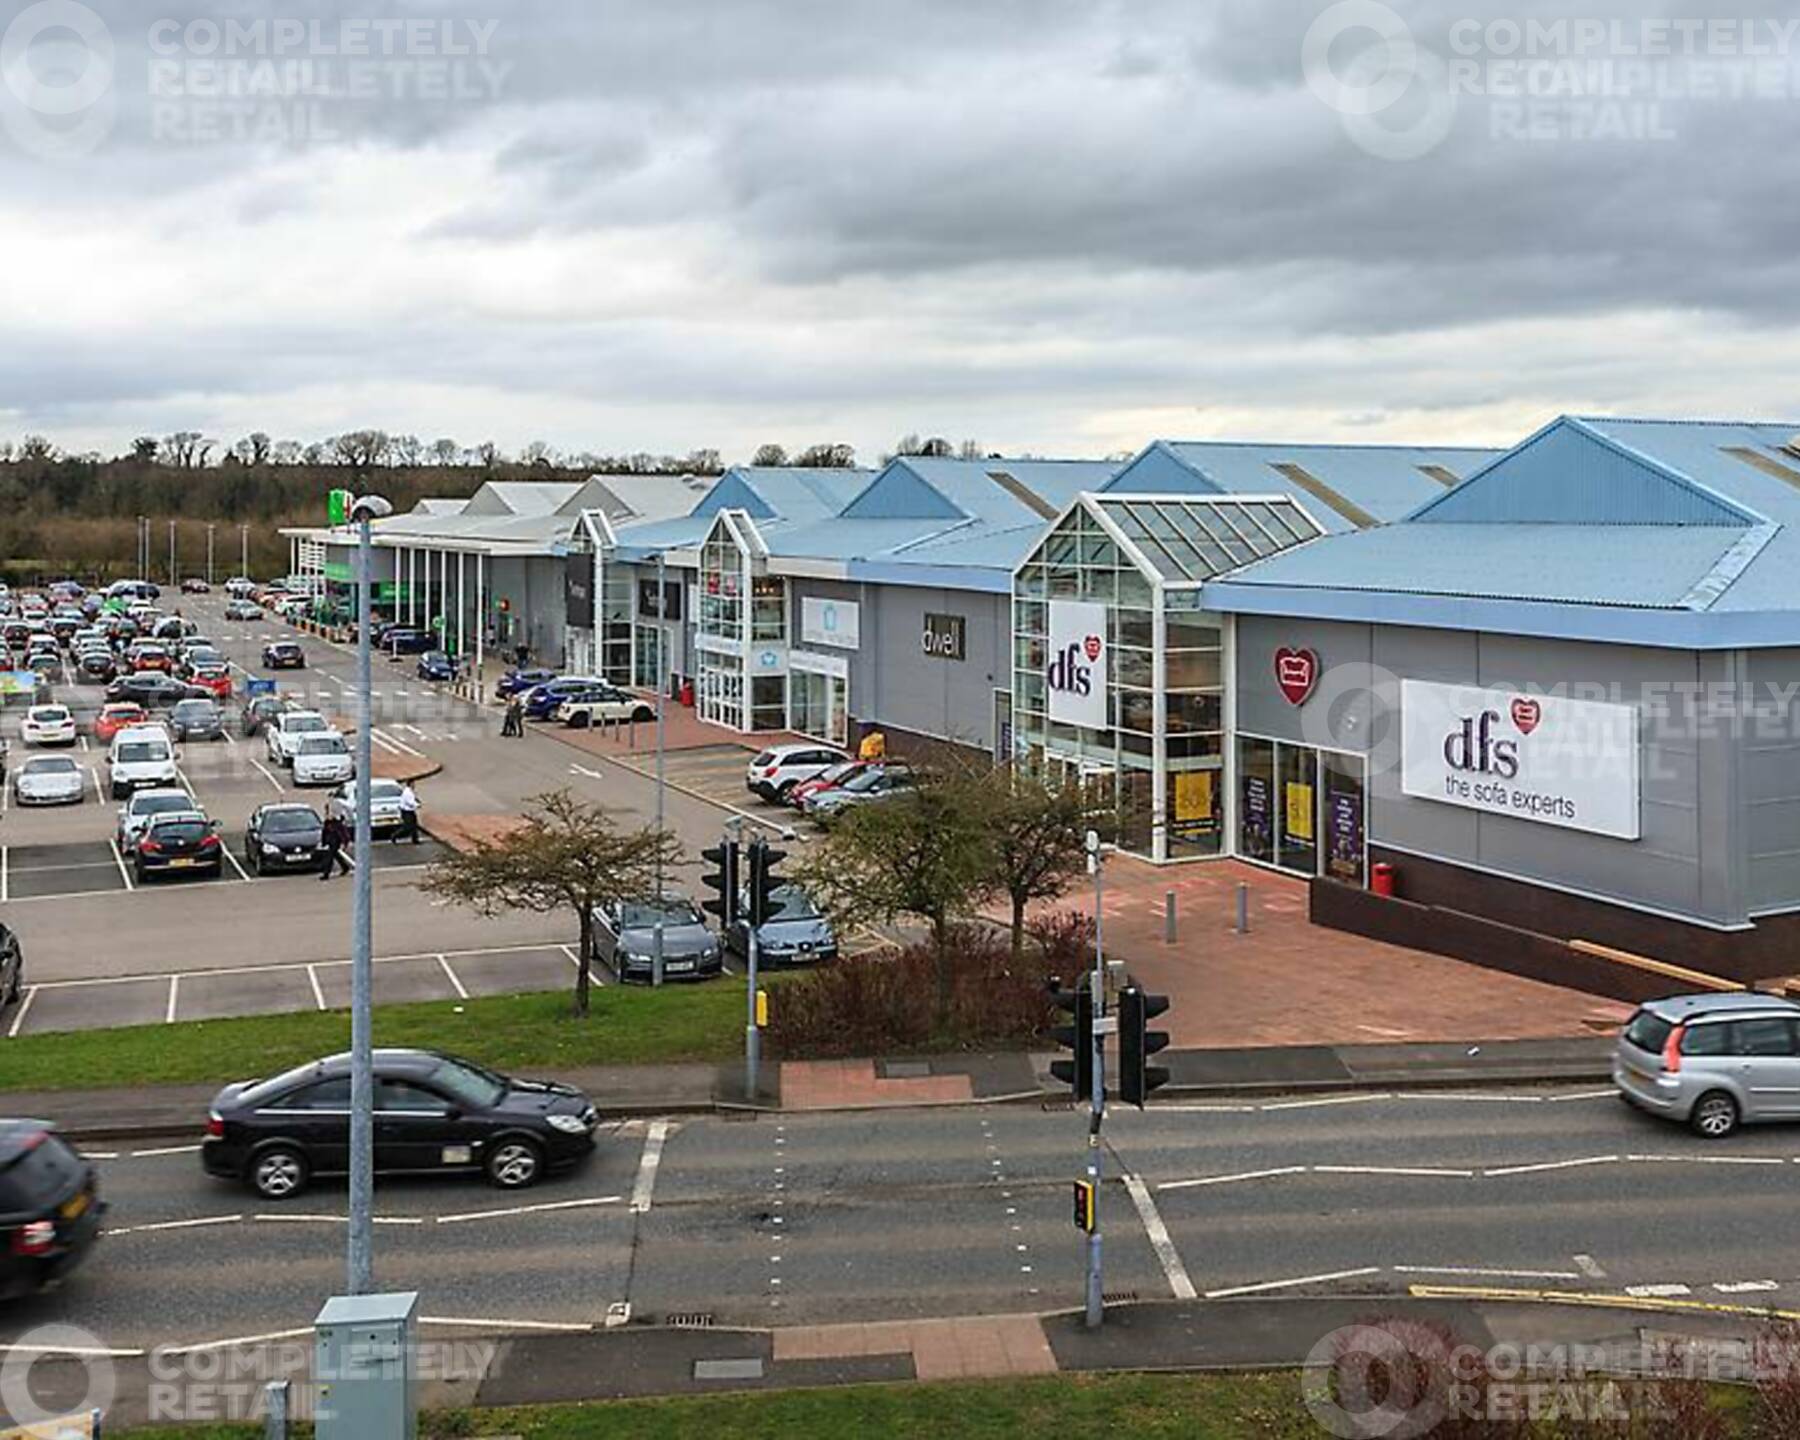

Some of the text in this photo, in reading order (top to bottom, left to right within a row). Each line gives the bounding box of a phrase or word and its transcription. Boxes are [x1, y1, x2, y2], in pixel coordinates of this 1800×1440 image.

[921, 616, 960, 656] dwell
[1048, 642, 1091, 697] dfs
[1444, 710, 1519, 780] dfs
[1445, 775, 1576, 819] the sofa experts
